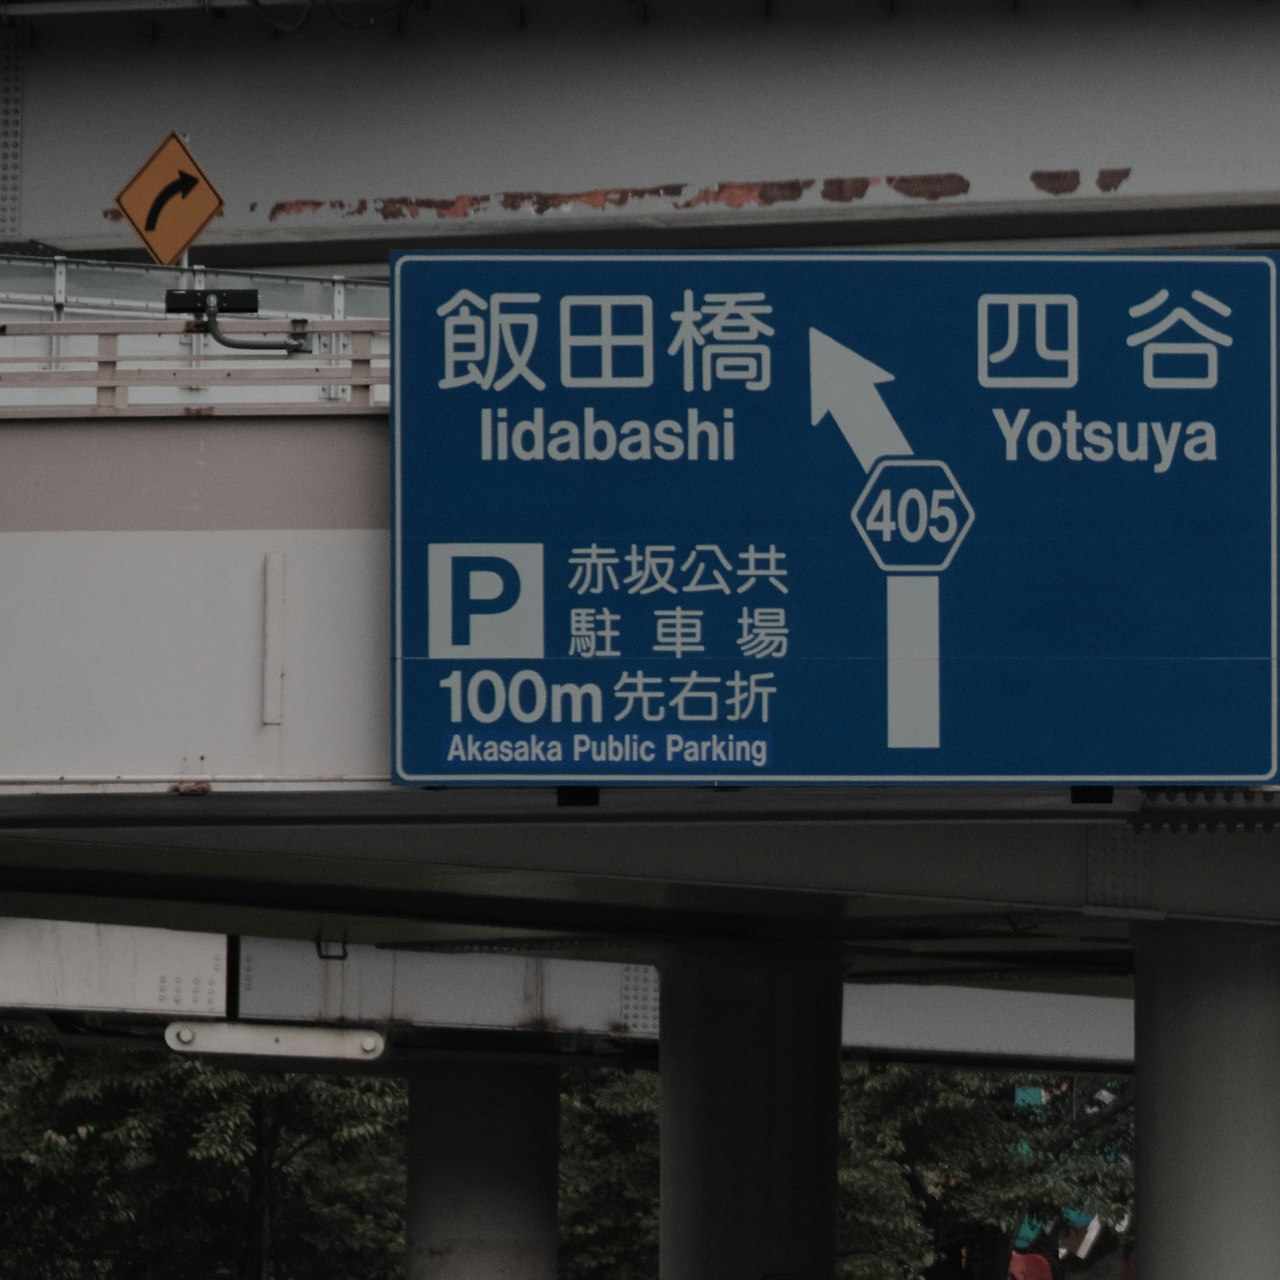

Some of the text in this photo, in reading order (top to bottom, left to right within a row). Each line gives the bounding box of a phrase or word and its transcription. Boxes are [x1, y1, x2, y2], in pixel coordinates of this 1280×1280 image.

[437, 289, 774, 392] 飯田橋
[977, 289, 1233, 390] 四谷
[481, 408, 735, 461] Iidabashi
[992, 408, 1217, 473] Yotsuya
[865, 488, 958, 543] 405
[568, 543, 789, 595] 赤坂公共
[451, 555, 522, 646] P
[568, 606, 789, 659] 駐車場
[447, 734, 767, 767] Akasaka Public Parking
